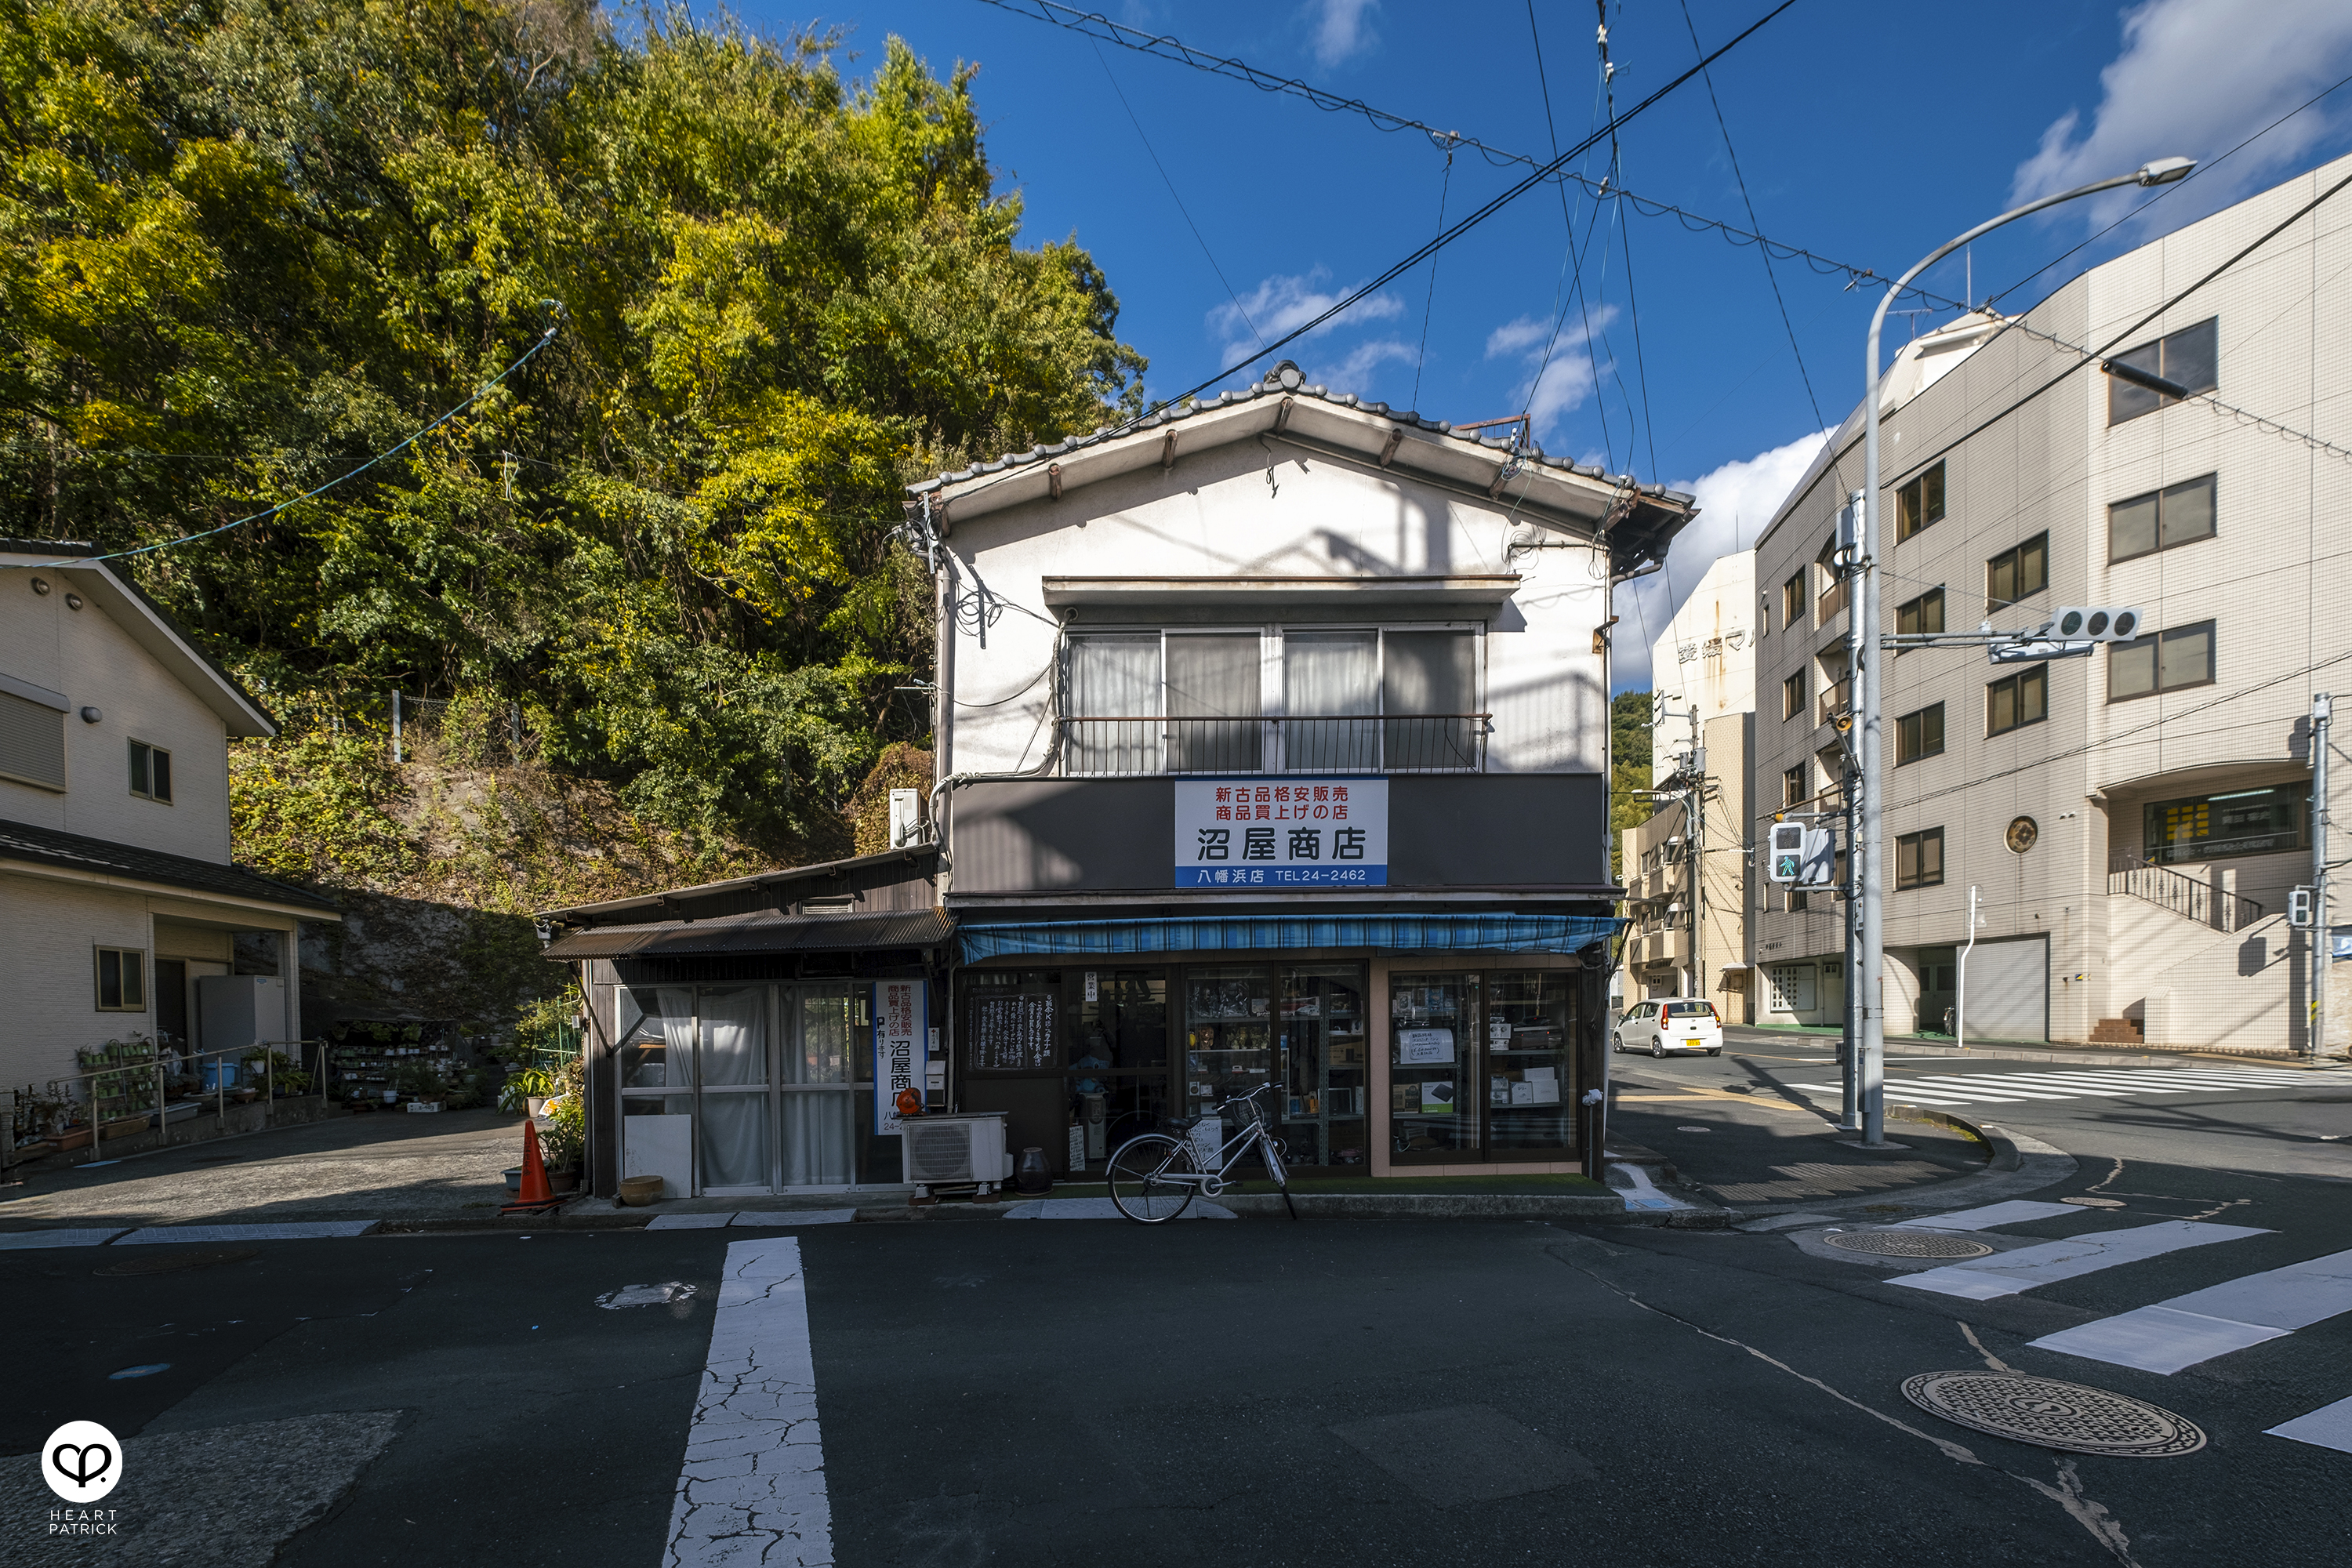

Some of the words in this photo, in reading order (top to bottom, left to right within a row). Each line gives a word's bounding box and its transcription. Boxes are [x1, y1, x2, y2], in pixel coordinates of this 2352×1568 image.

[1215, 786, 1348, 803] 新古品格安販売
[1215, 804, 1348, 821] 商品買上げの店
[1197, 826, 1367, 861] 沼屋商店
[1197, 869, 1265, 884] 八幡浜店
[1087, 972, 1096, 999] 営業中
[887, 985, 900, 1036] 商品買上げの店
[900, 984, 913, 1036] 新古品格安販売
